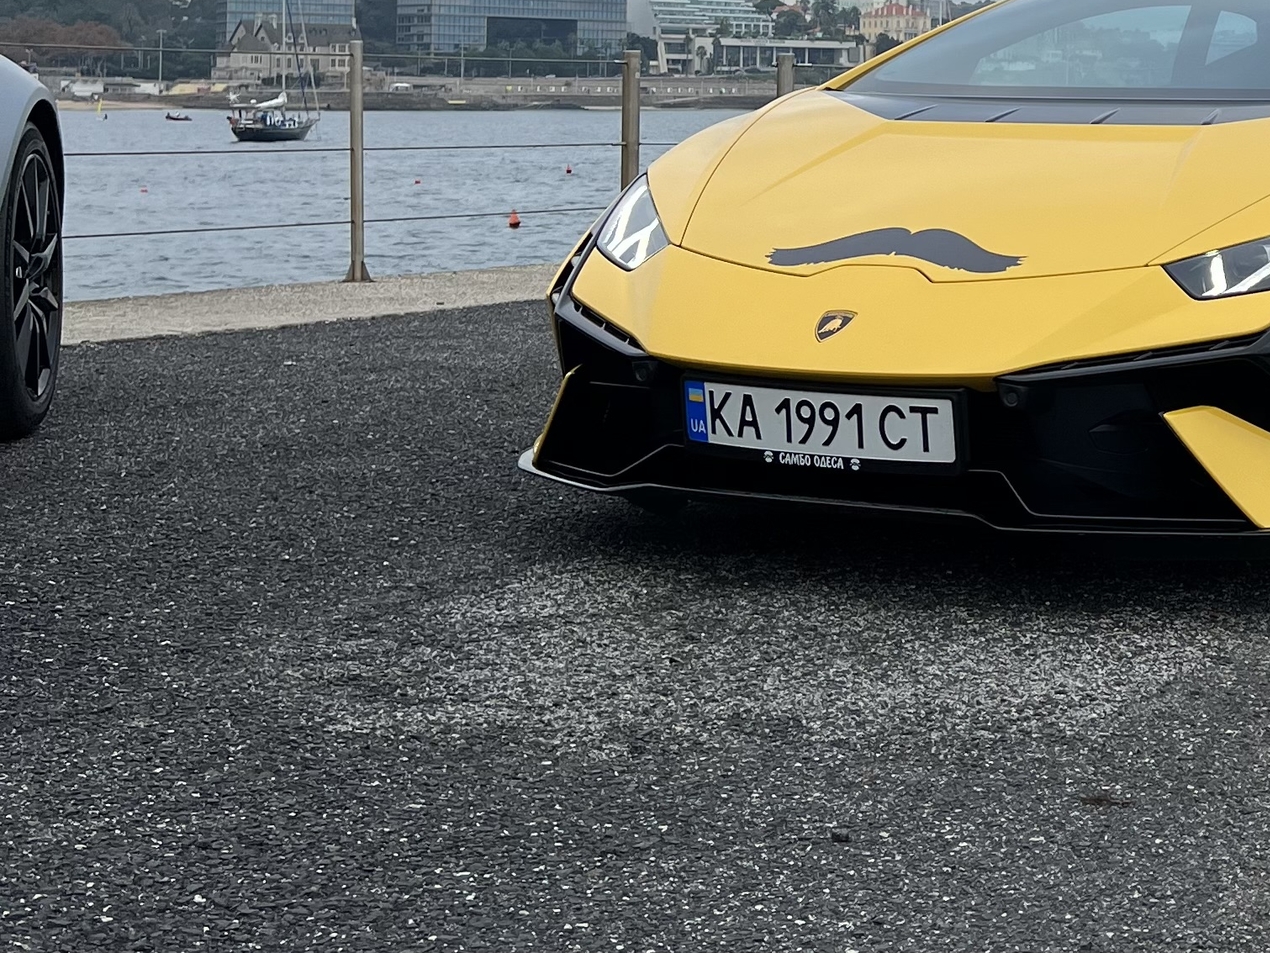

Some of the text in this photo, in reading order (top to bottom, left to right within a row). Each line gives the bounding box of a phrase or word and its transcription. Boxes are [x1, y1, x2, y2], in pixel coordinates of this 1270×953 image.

[690, 418, 706, 434] UA
[708, 389, 939, 453] KA 1991 CT
[779, 452, 844, 469] САМБО ОДЕСА
